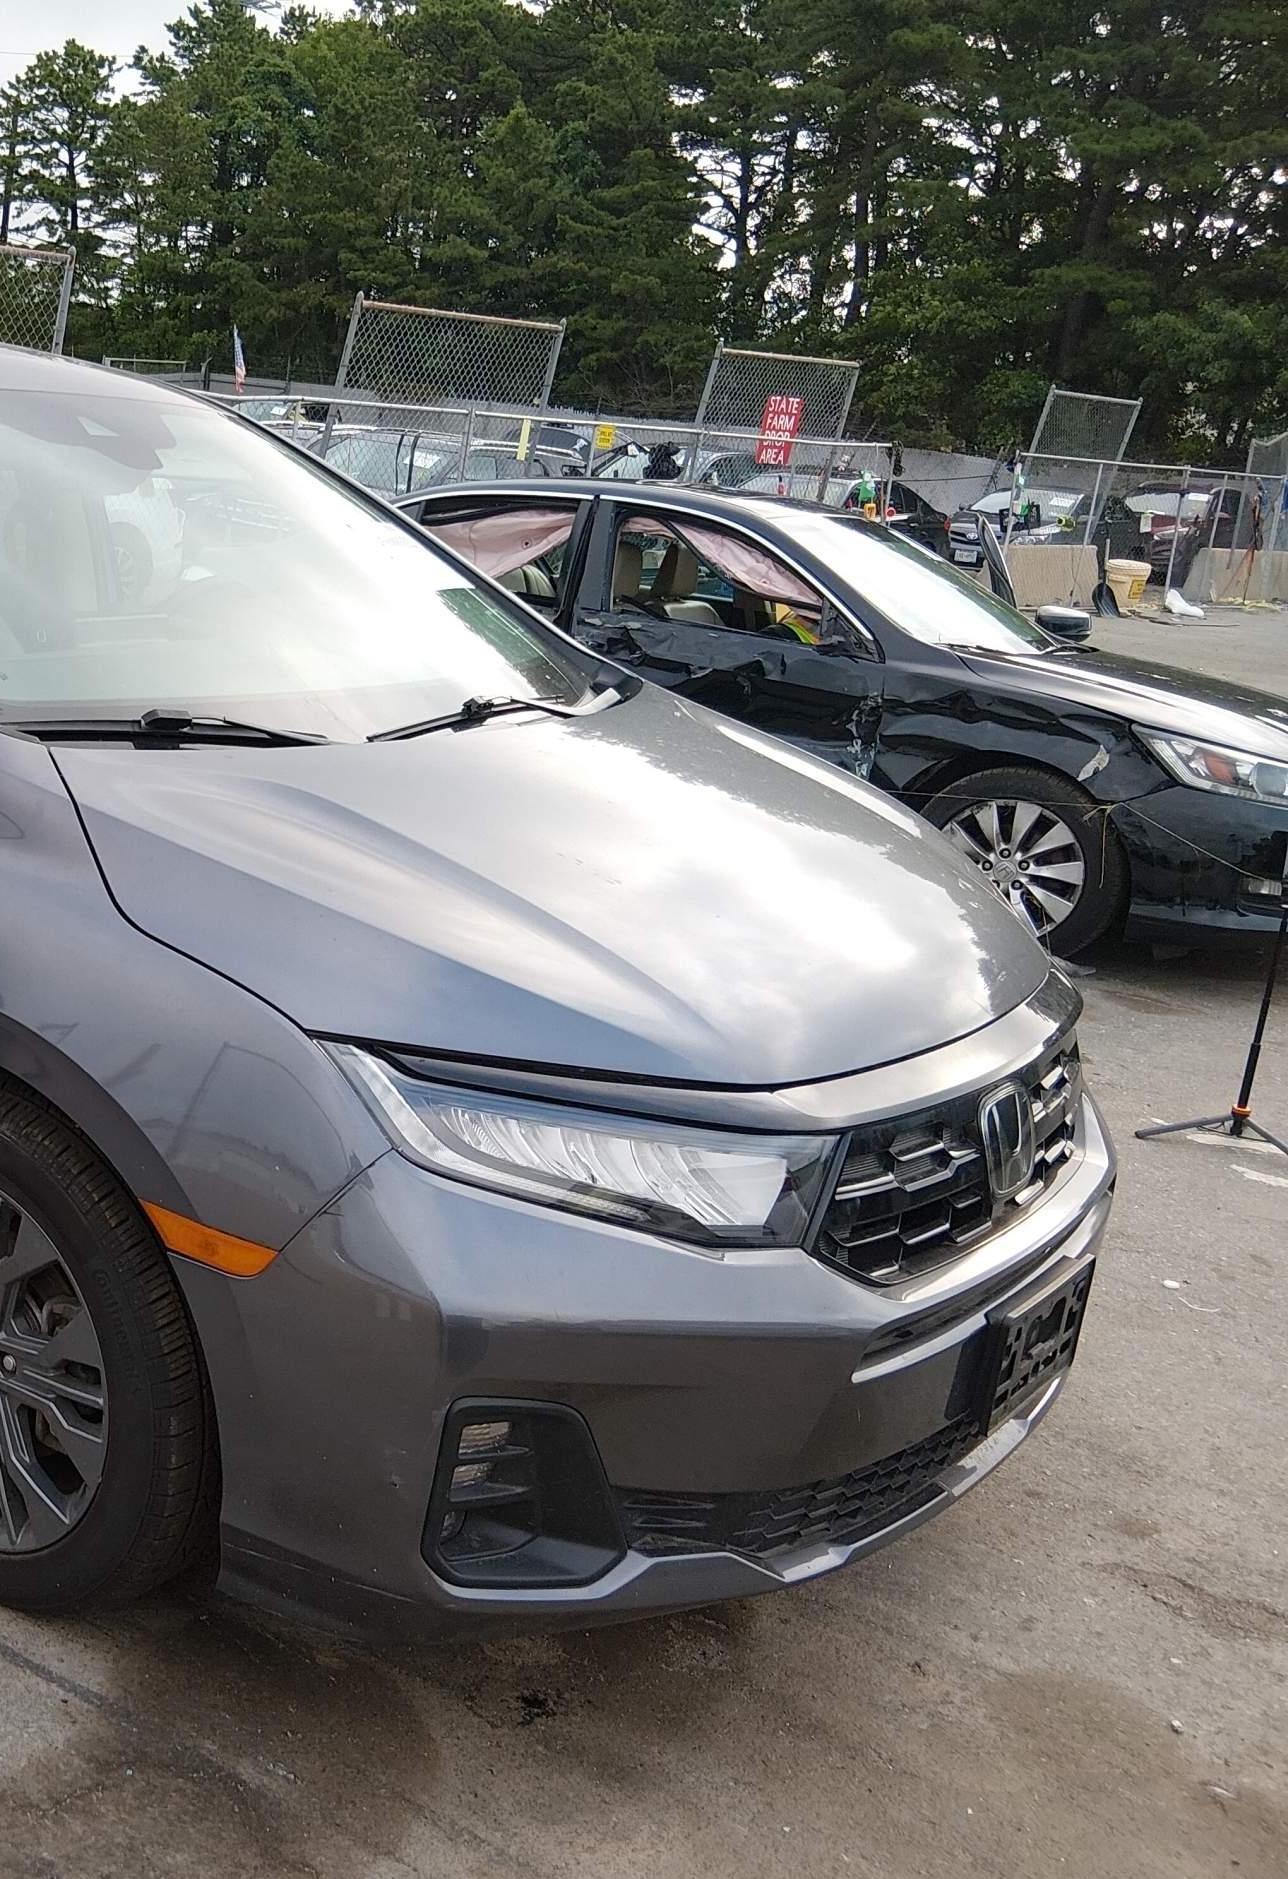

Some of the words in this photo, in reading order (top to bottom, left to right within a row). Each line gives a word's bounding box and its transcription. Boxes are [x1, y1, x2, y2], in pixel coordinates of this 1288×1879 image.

[769, 396, 801, 413] STATE
[766, 413, 795, 431] FARM
[763, 431, 790, 447] DROP
[759, 448, 784, 465] AREA
